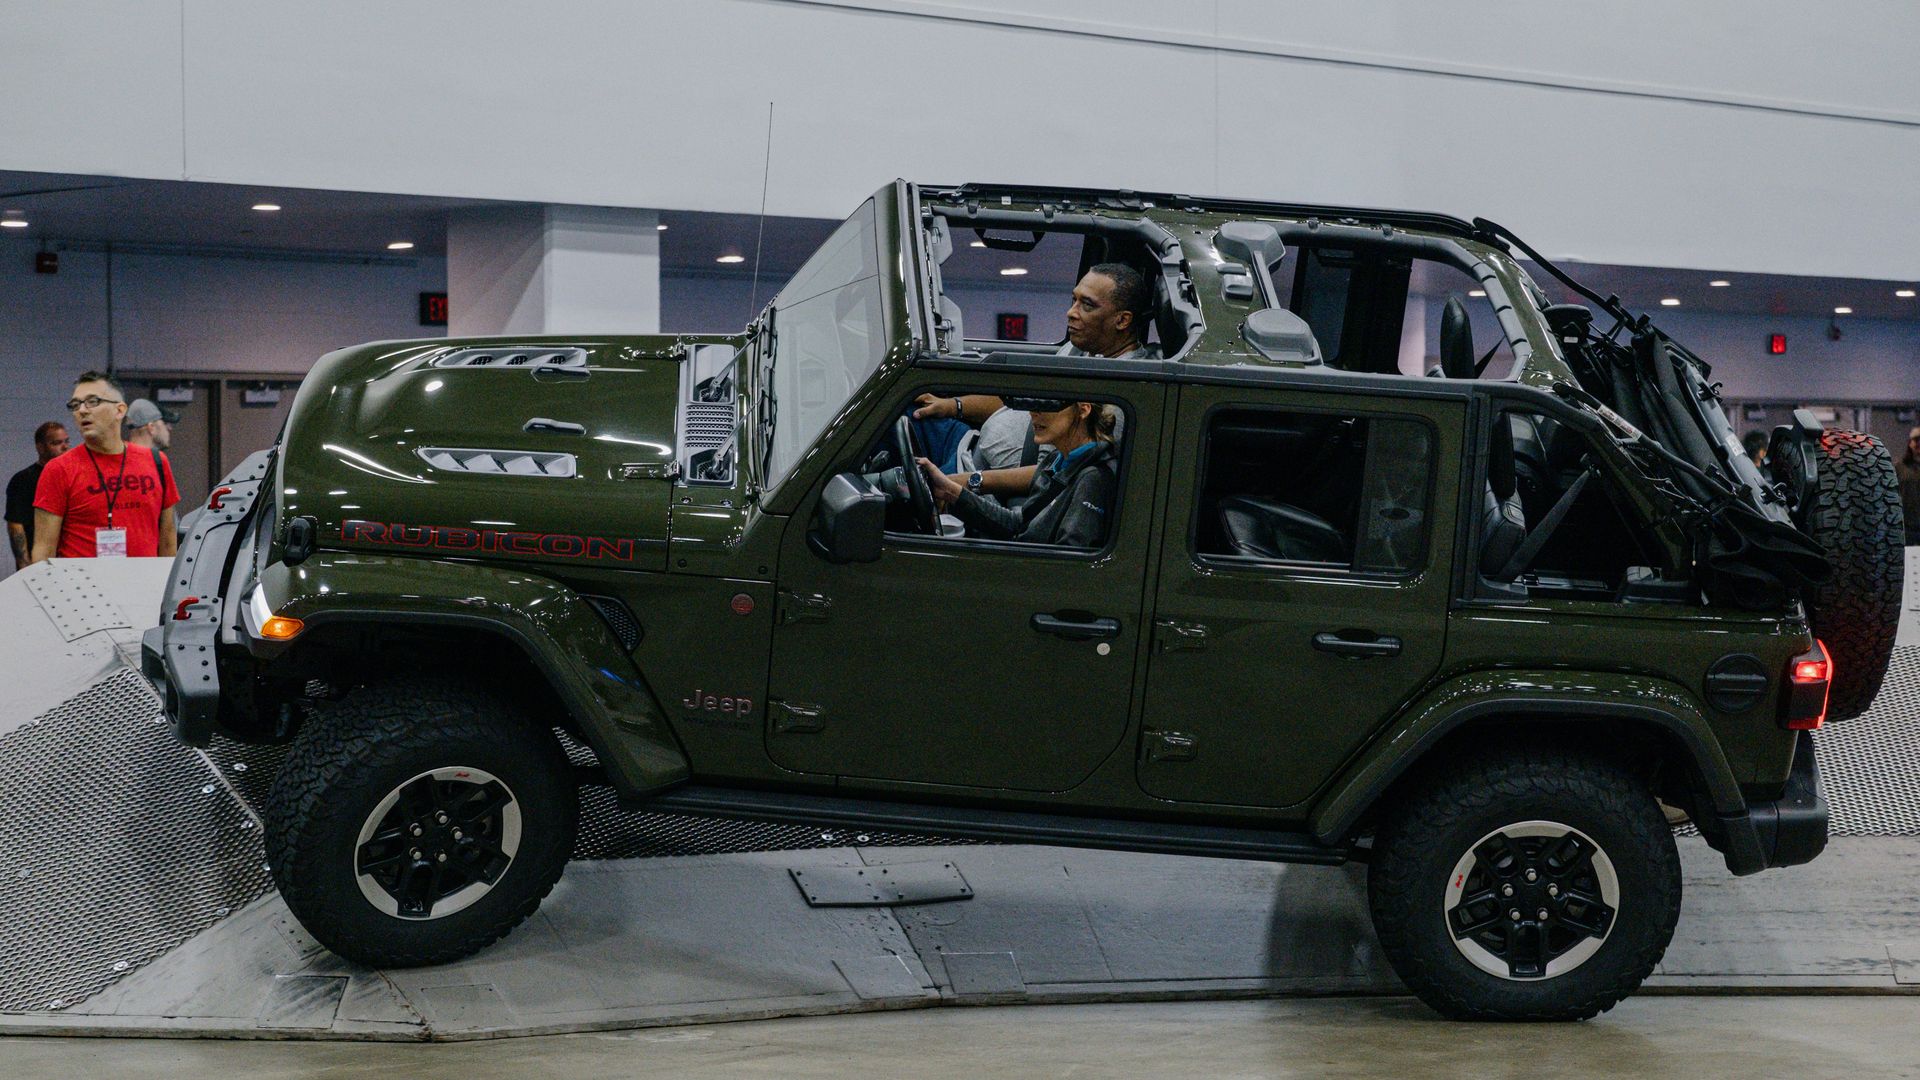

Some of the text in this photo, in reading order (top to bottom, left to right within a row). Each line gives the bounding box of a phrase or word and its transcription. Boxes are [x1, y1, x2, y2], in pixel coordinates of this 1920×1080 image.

[86, 473, 155, 495] Jeep
[340, 518, 635, 561] RUBICON
[682, 689, 753, 718] Jeep
